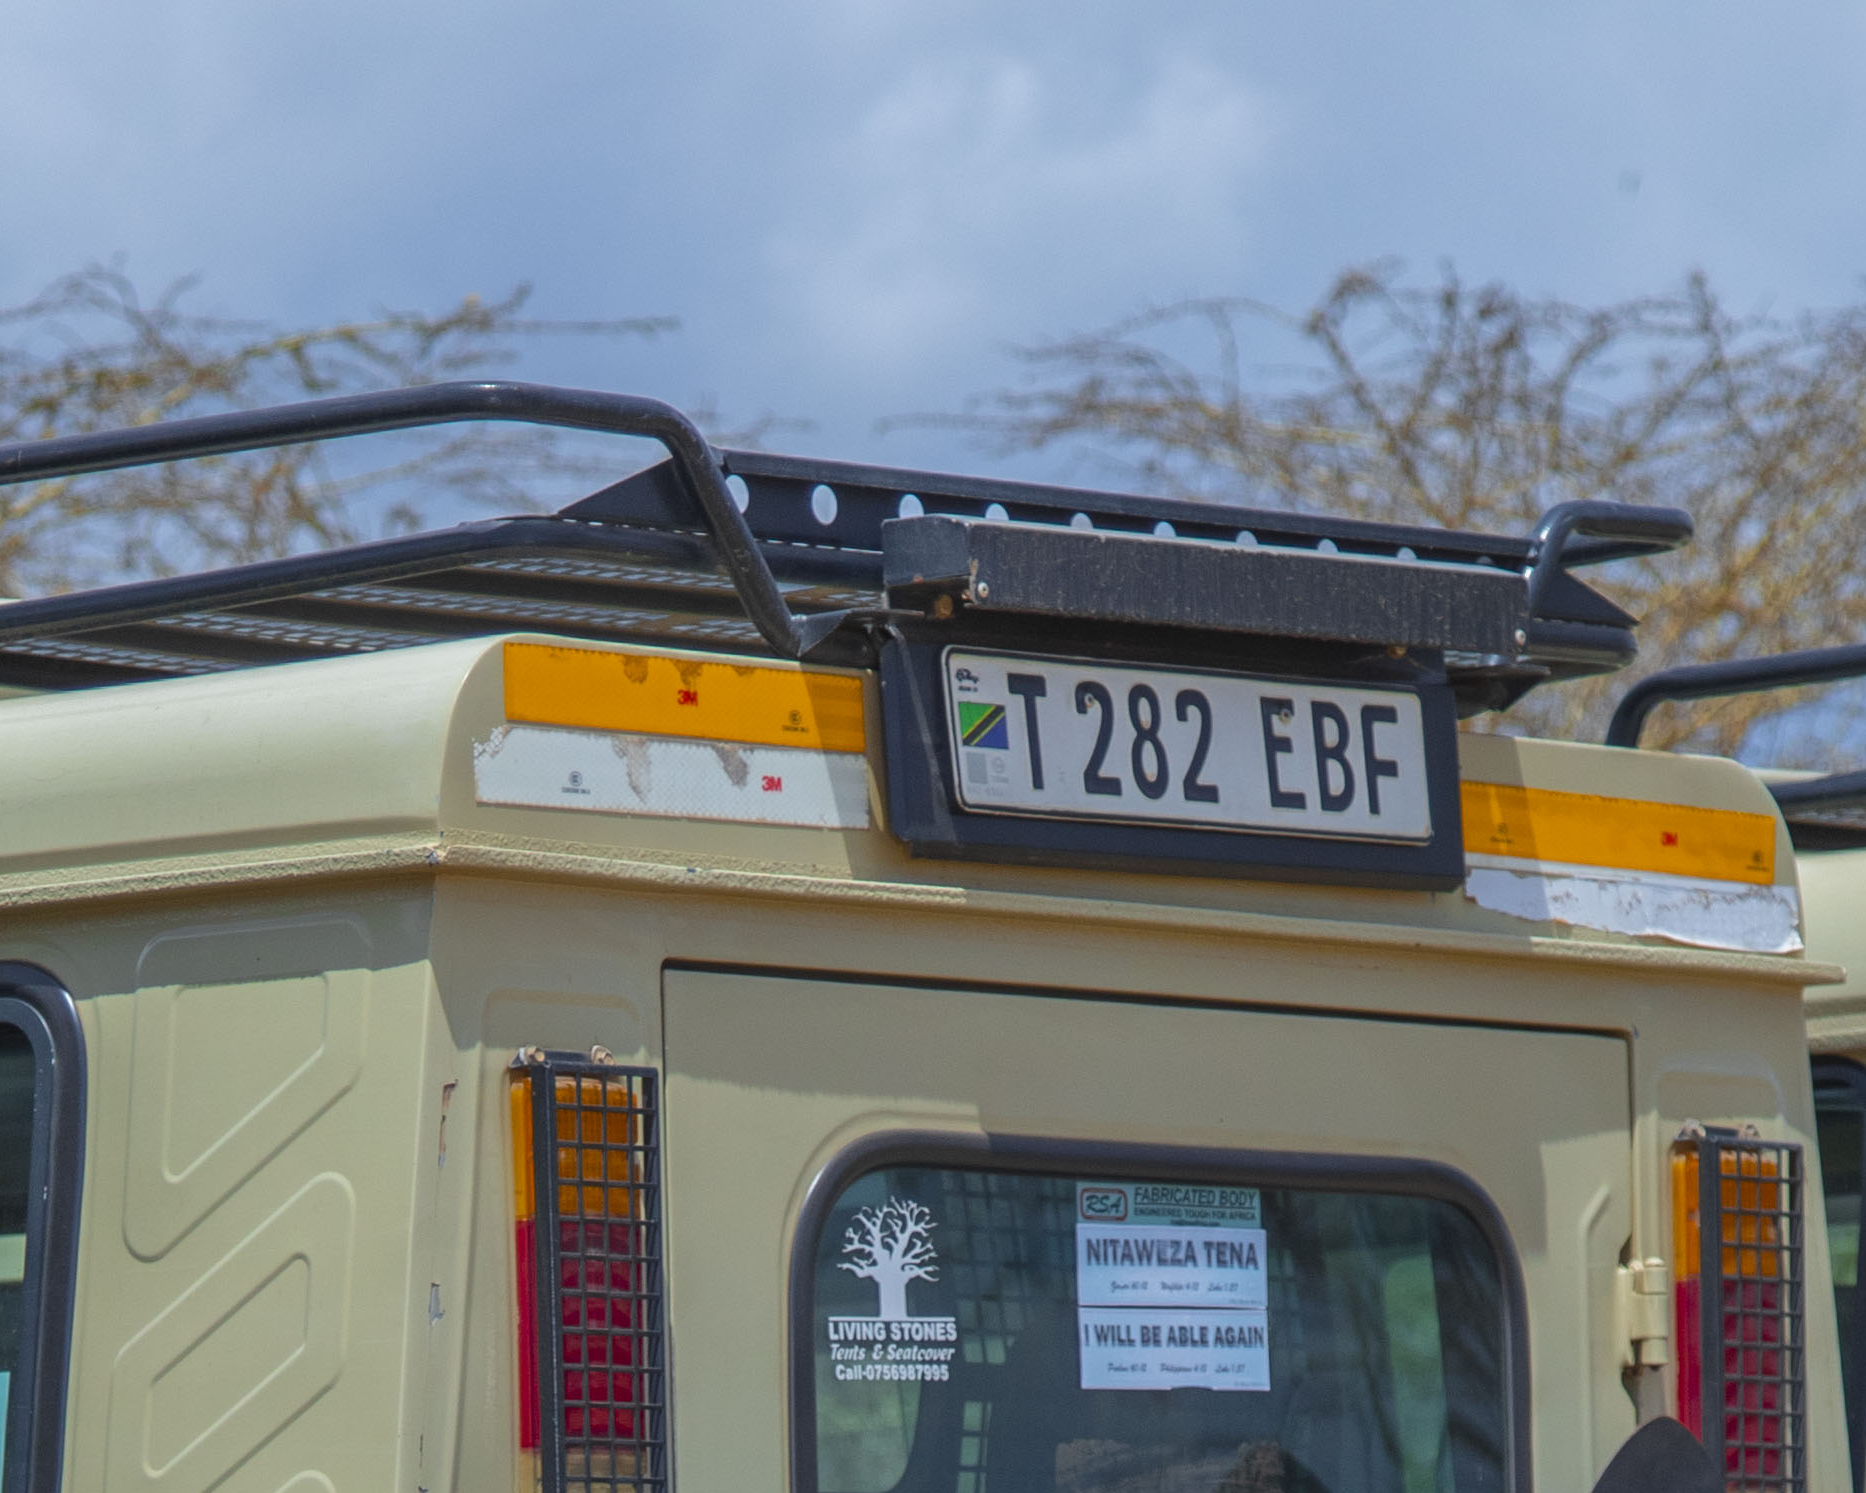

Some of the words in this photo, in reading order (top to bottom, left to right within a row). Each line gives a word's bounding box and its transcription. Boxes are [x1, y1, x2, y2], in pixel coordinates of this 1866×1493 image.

[677, 689, 698, 706] 3M
[1007, 672, 1047, 791] T
[1075, 680, 1221, 804] 282
[1259, 696, 1400, 815] EBF
[762, 775, 782, 792] 3M
[1134, 1186, 1217, 1204] FABRICATED
[1219, 1189, 1257, 1207] BODY
[1086, 1238, 1199, 1268] NITAWEZA
[1203, 1240, 1260, 1270] TENA
[828, 1322, 887, 1341] LIVING
[890, 1321, 958, 1341] STONES
[1084, 1323, 1090, 1346] I
[1094, 1324, 1136, 1347] WILL
[1140, 1325, 1162, 1347] BE
[1167, 1325, 1209, 1348] ABLE
[1214, 1326, 1265, 1349] AGAIN
[830, 1343, 866, 1361] Tents
[872, 1343, 884, 1361] &
[886, 1343, 956, 1361] Seatcover
